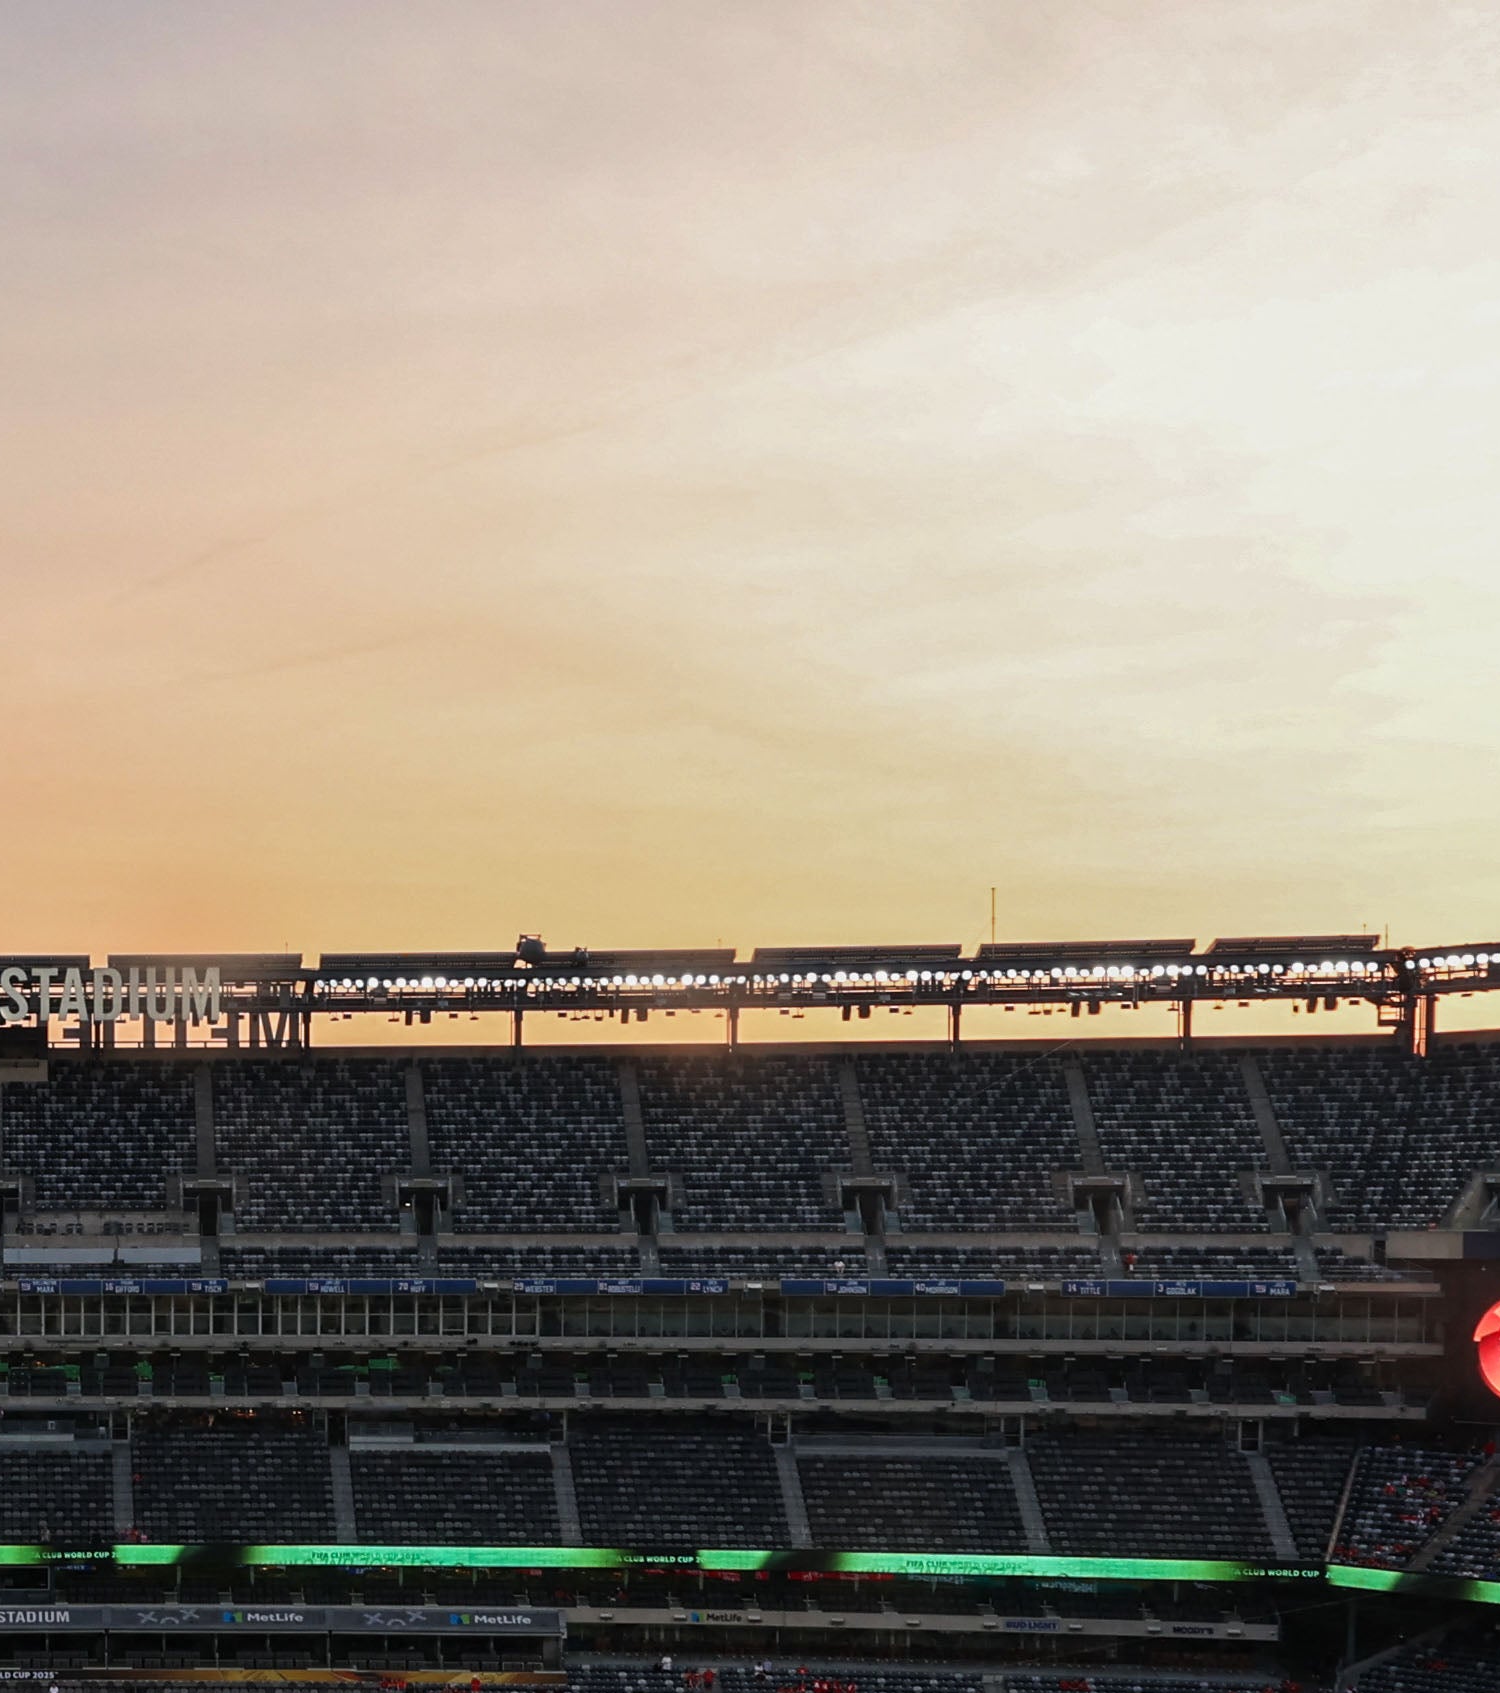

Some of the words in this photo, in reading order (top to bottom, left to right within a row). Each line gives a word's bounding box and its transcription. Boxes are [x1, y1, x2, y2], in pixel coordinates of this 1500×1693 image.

[1080, 1287, 1101, 1295] TITTLE
[63, 1551, 92, 1559] WORLD
[646, 1555, 676, 1564] WORLD
[676, 1556, 694, 1564] CUP
[1267, 1569, 1300, 1577] WORLD
[1301, 1570, 1320, 1578] CUP
[247, 1613, 305, 1623] MetLife
[474, 1614, 532, 1625] MetLife
[706, 1614, 743, 1622] MetLife
[1028, 1621, 1058, 1629] LIGHT
[1173, 1626, 1214, 1635] MOODY'S
[13, 1671, 31, 1680] CUP
